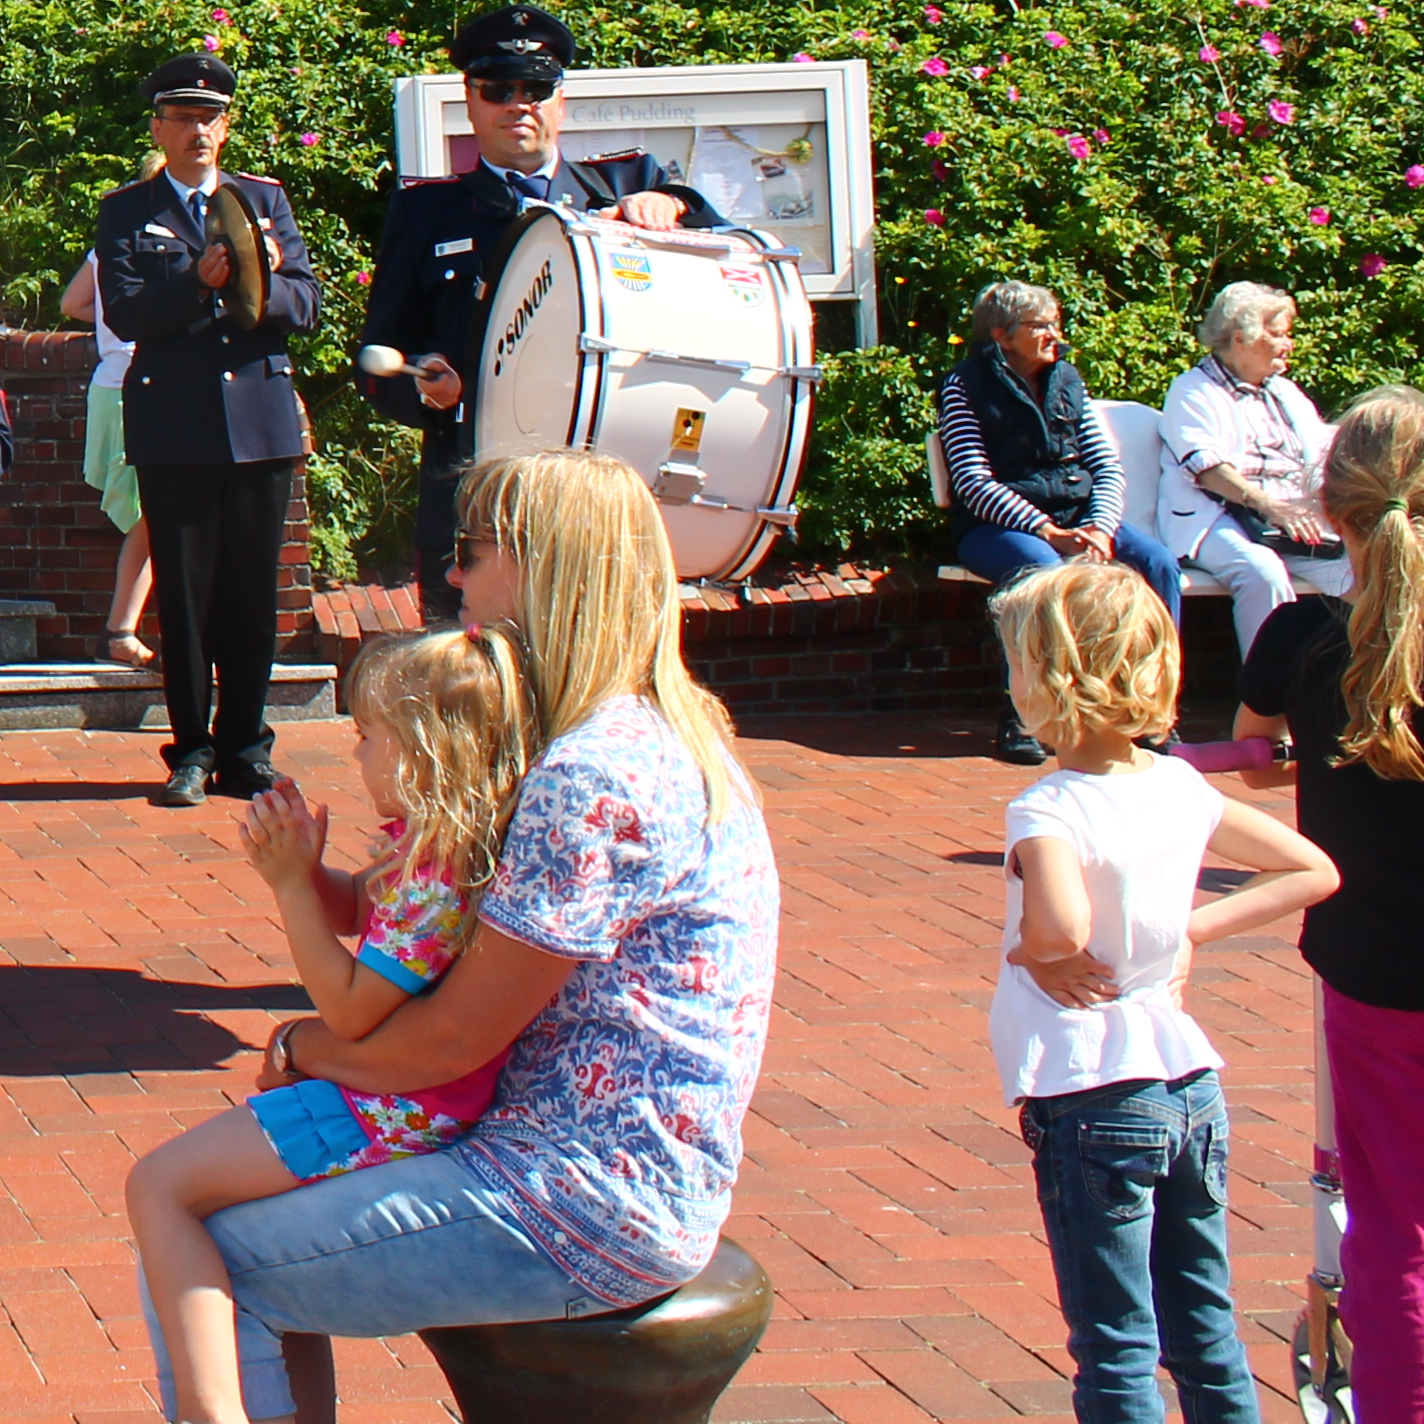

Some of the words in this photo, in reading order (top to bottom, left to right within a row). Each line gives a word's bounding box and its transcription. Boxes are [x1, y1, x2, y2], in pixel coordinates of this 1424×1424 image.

[572, 104, 613, 124] Café
[619, 102, 697, 125] Pudding
[505, 259, 553, 355] SONOR
